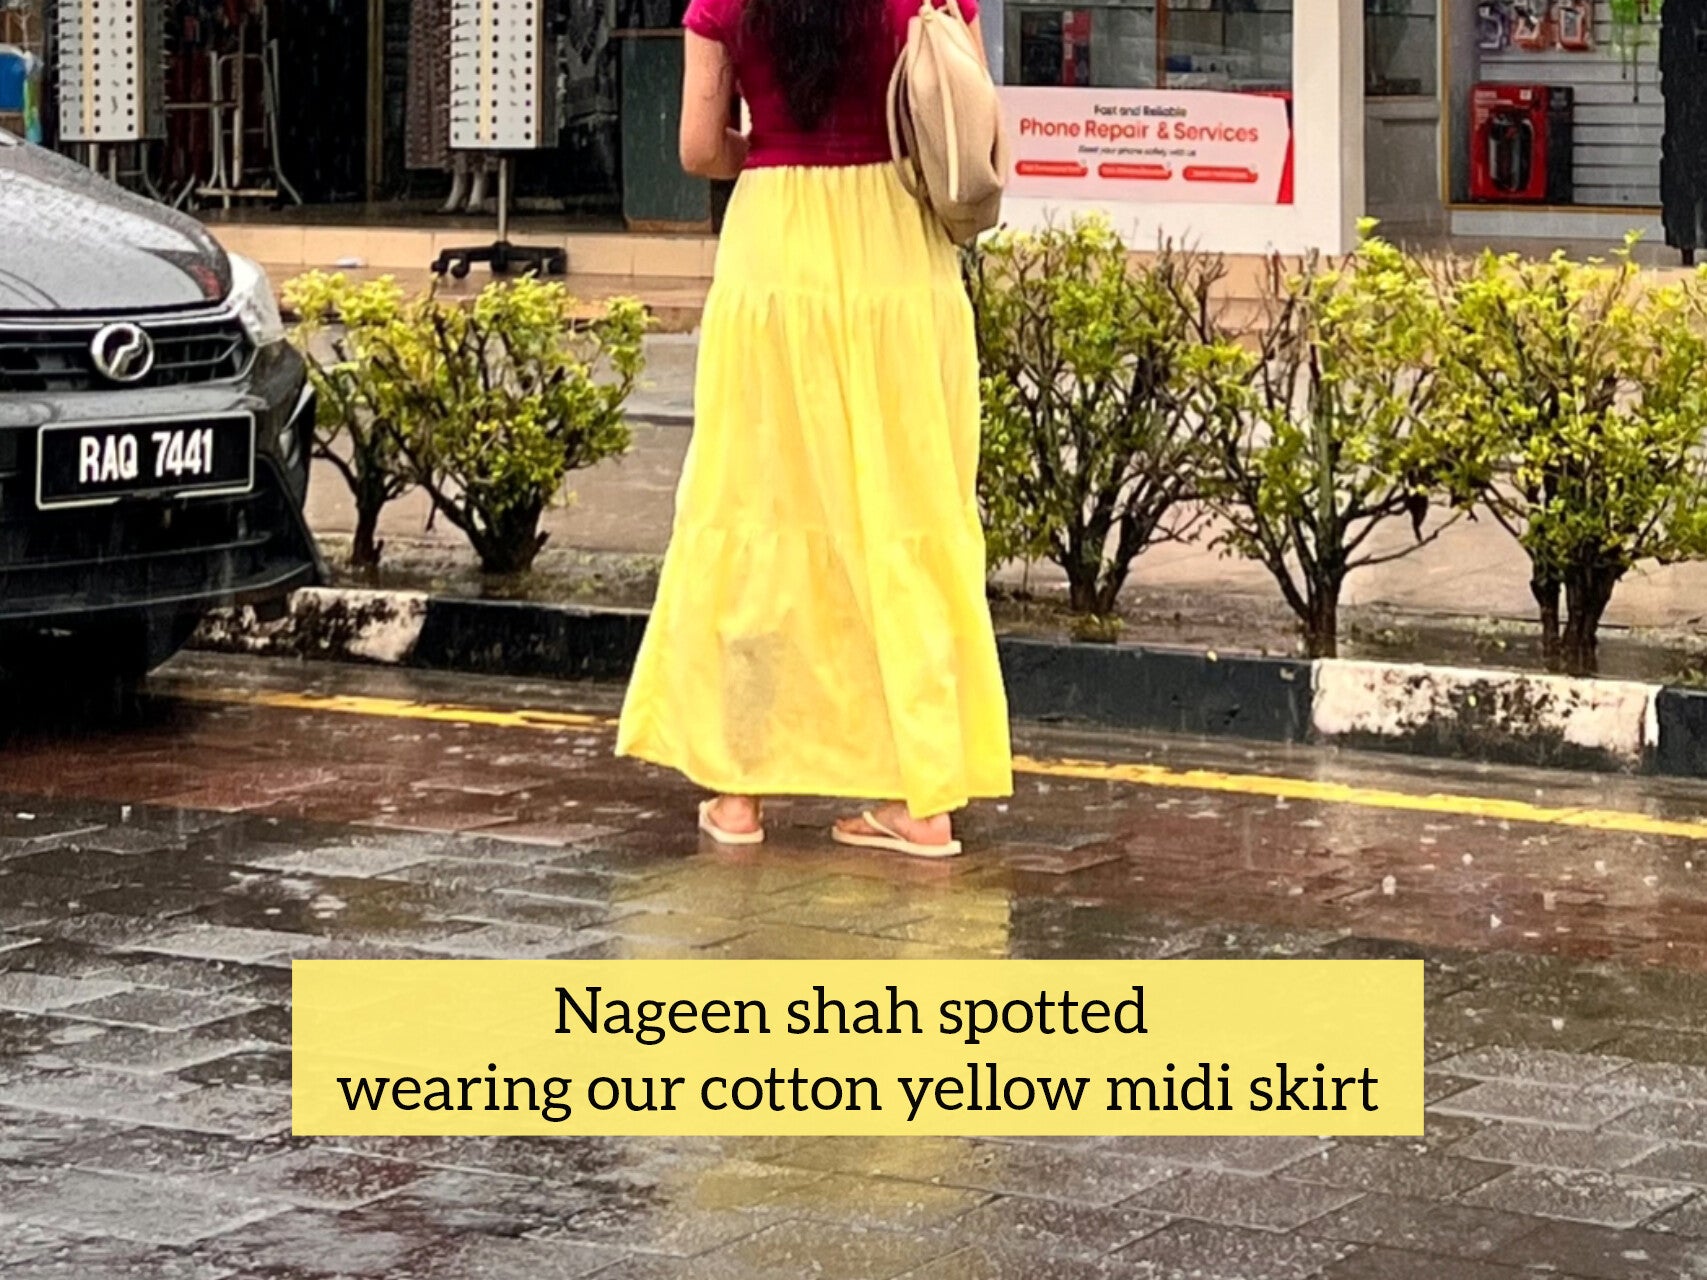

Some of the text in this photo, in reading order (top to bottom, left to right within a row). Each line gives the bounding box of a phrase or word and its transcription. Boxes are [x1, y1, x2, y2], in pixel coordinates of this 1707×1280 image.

[1094, 105, 1187, 118] Fast and Reliable
[1019, 118, 1259, 143] Phone Repair & Services
[79, 428, 213, 483] RAQ 7441
